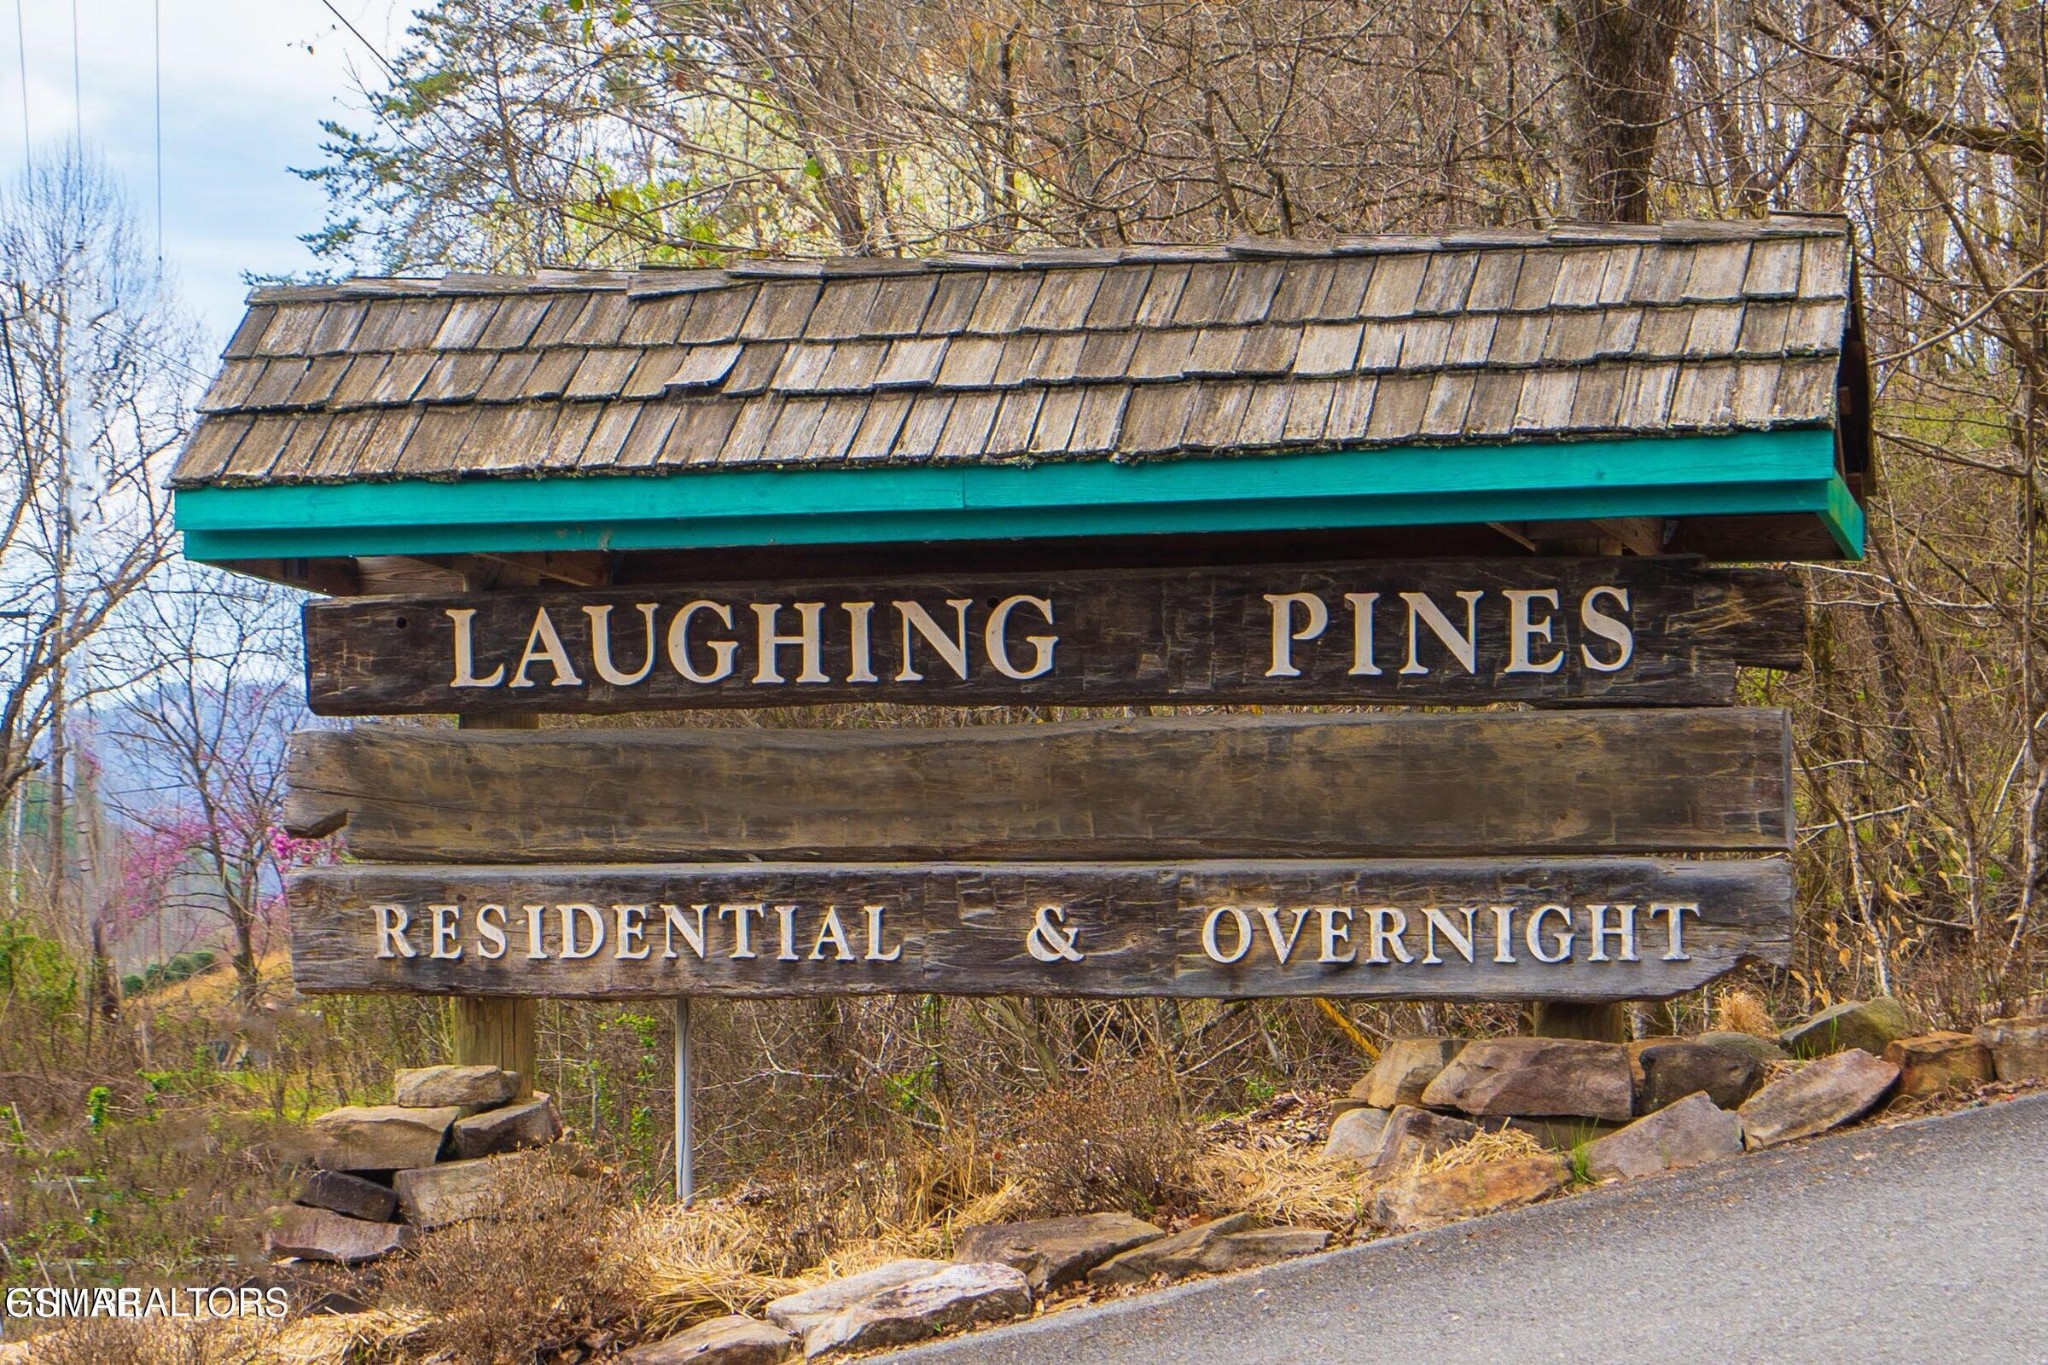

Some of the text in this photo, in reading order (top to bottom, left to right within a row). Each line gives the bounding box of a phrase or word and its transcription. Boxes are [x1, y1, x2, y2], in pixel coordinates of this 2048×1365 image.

[446, 586, 1634, 689] LAUGHING PINES
[372, 901, 1700, 964] RESIDENTIAL & OVERNIGHT
